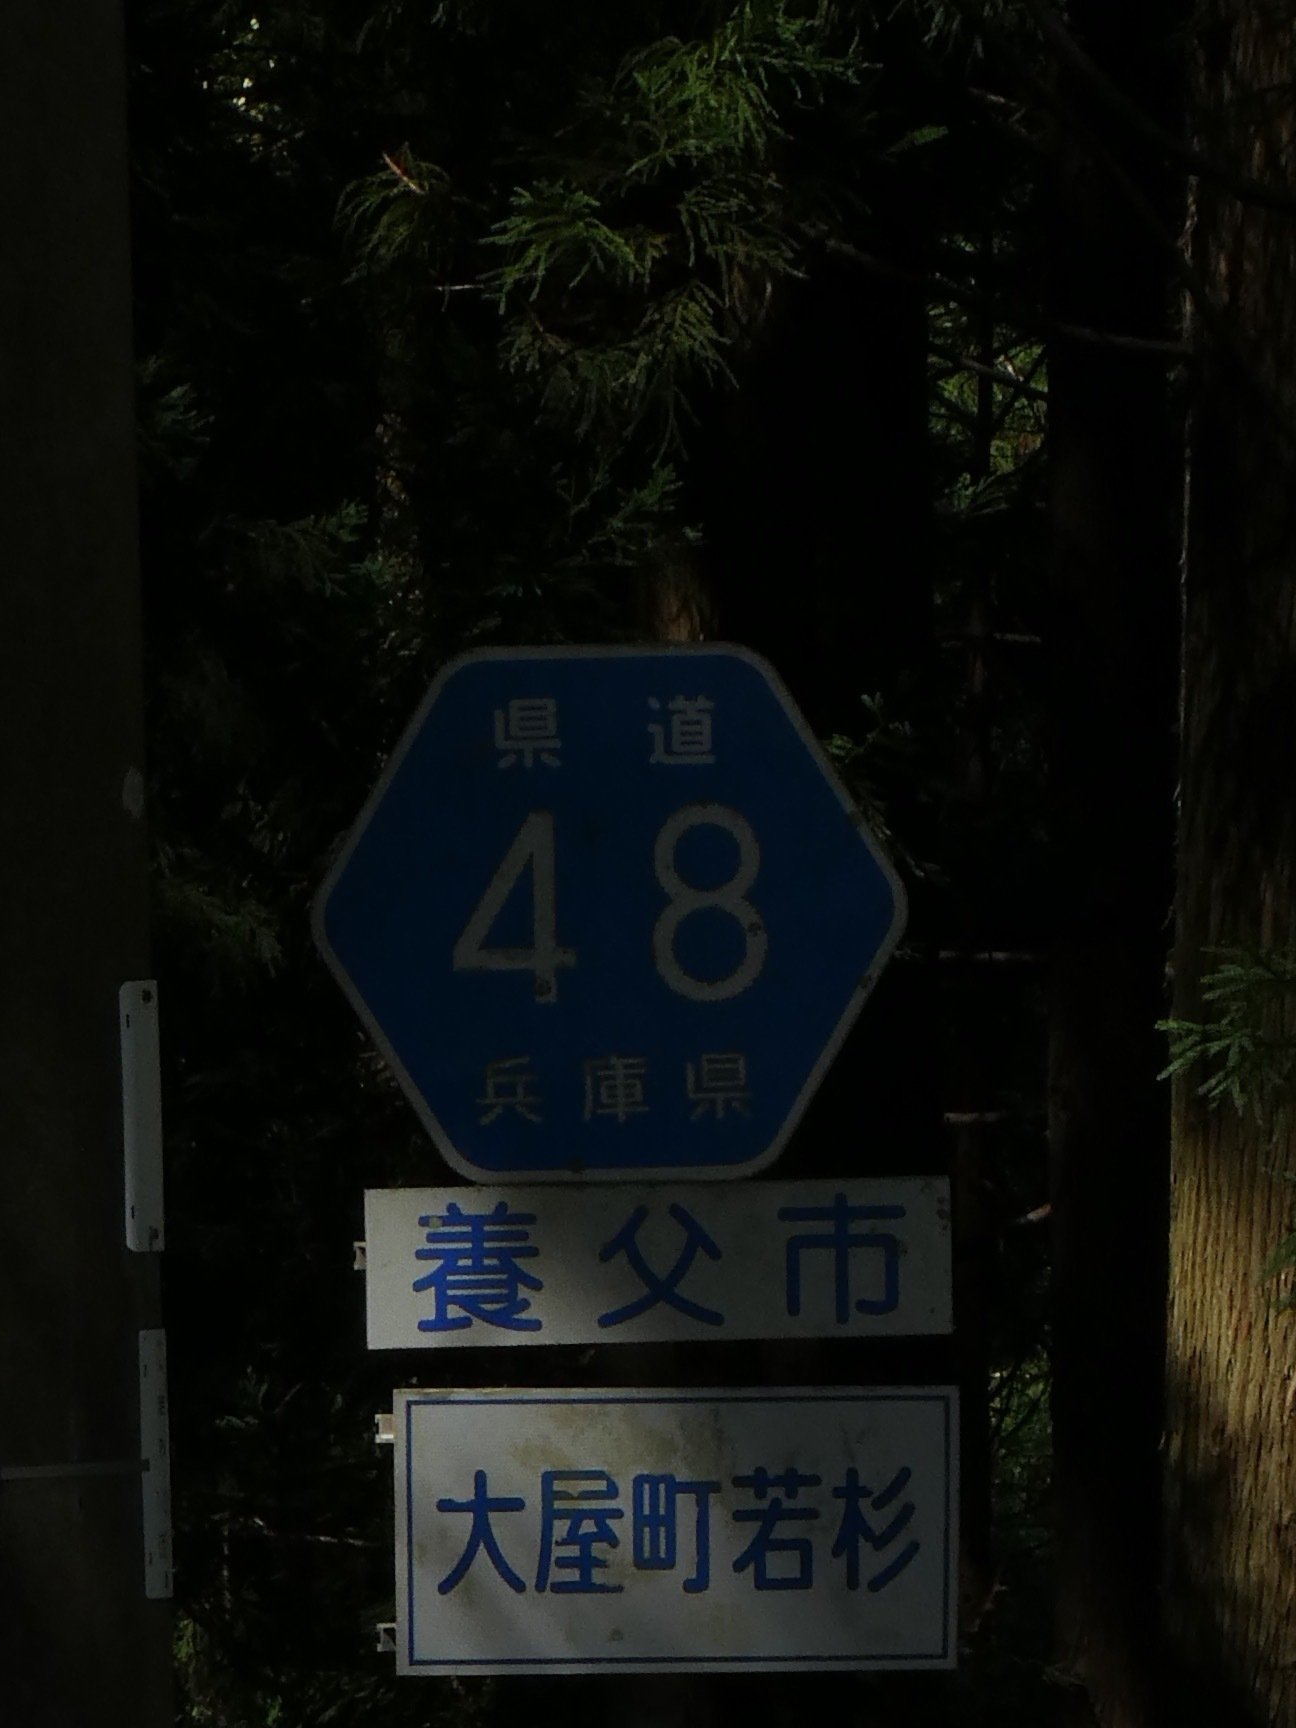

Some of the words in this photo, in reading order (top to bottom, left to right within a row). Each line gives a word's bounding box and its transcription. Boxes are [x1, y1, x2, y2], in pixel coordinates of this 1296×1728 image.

[450, 800, 770, 1004] 48
[410, 1190, 907, 1334] 養父市
[434, 1465, 922, 1598] 大屋町若杉
